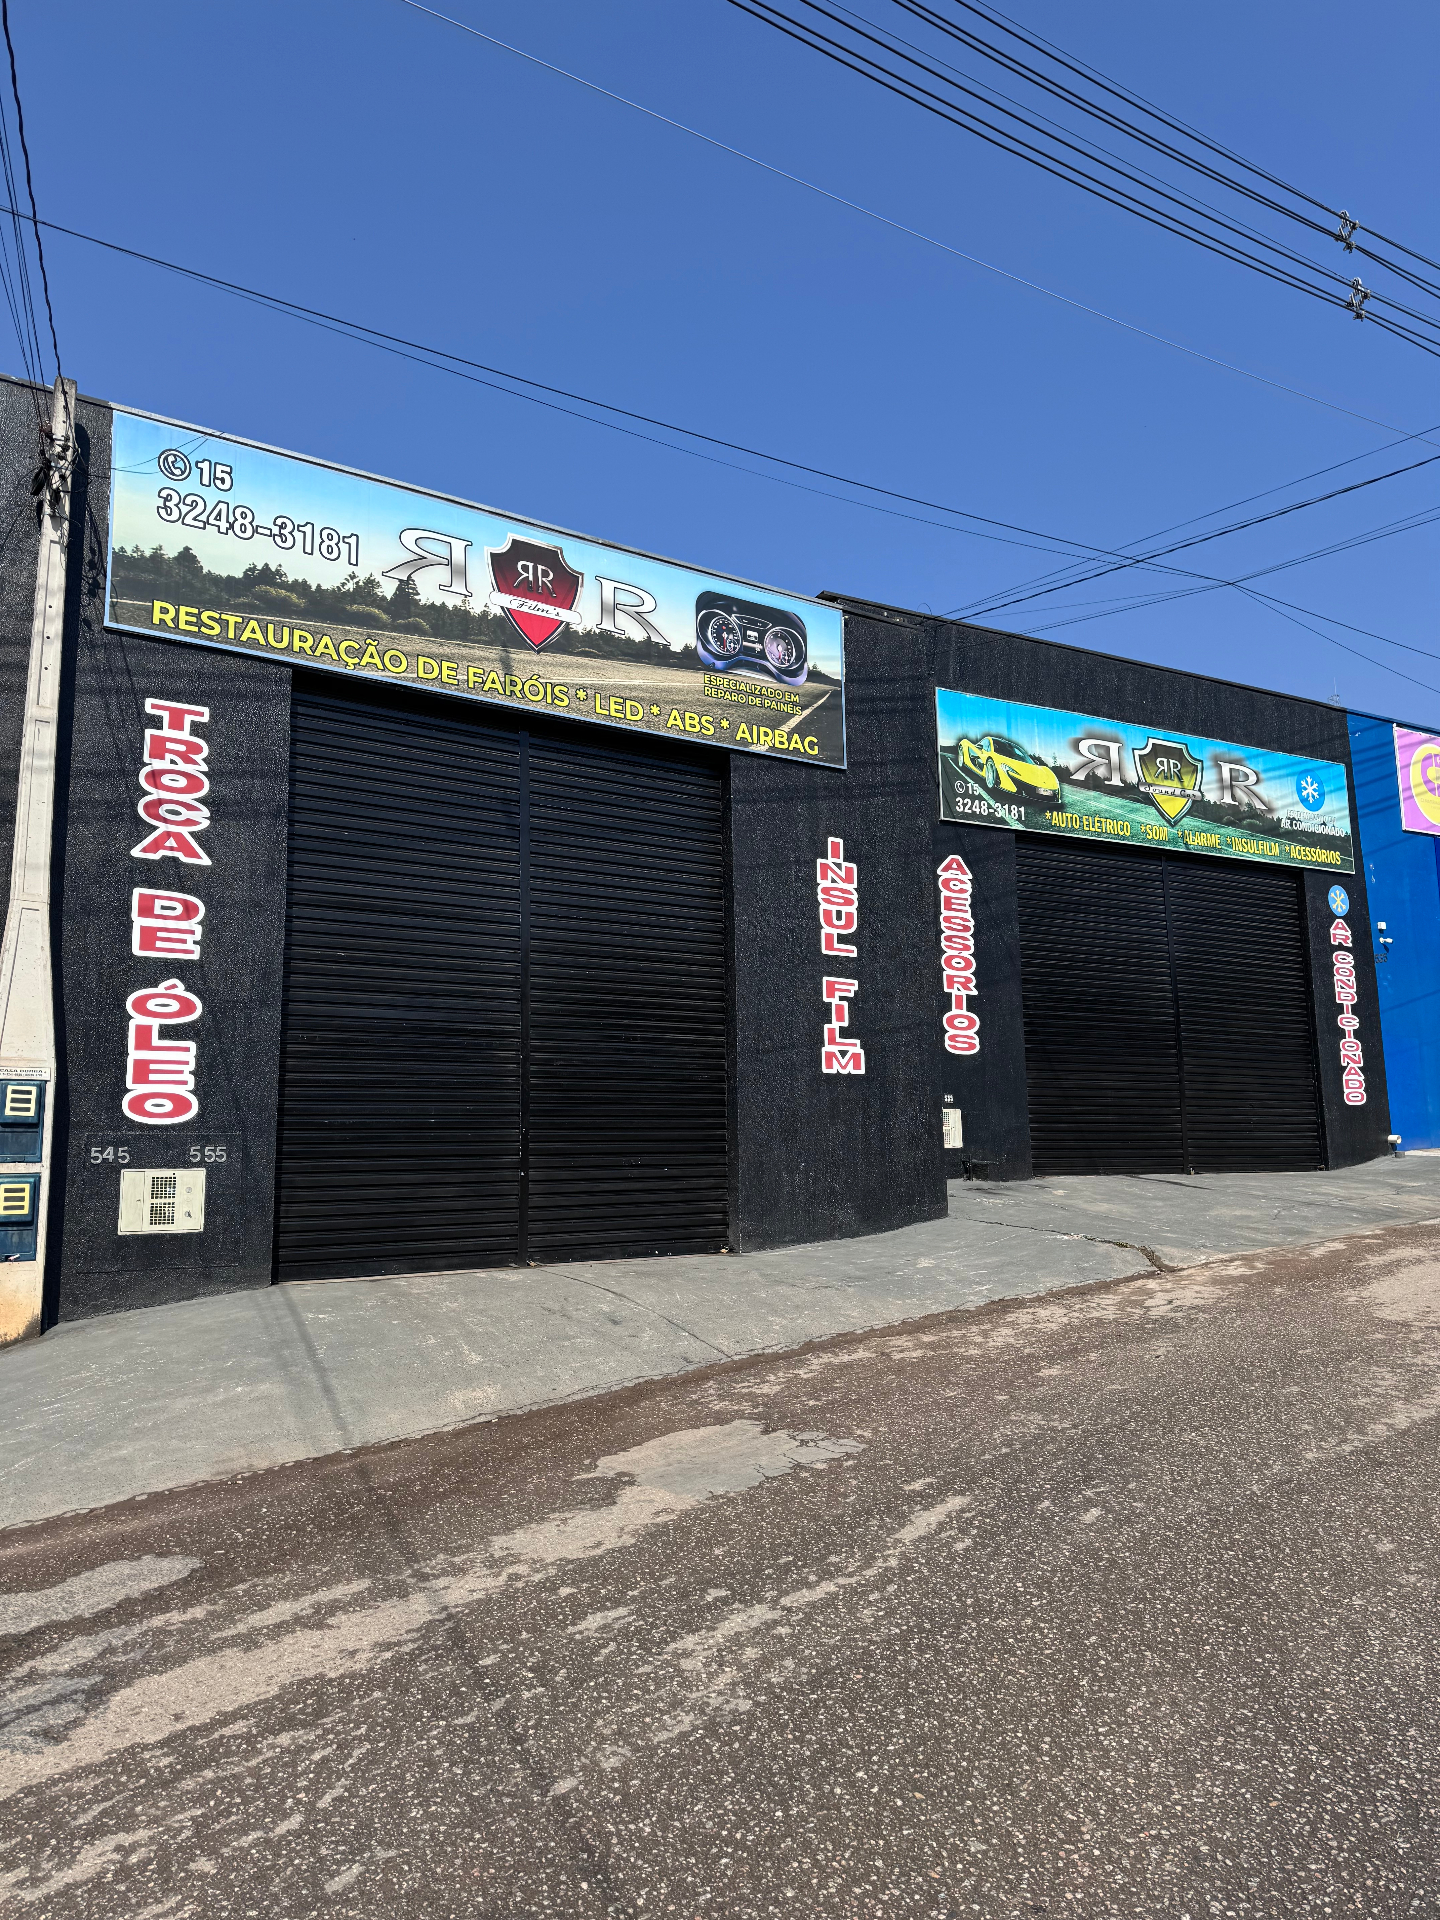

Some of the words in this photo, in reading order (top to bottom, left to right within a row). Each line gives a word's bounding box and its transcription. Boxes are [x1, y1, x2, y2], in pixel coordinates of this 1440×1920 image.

[196, 458, 233, 492] 15
[156, 487, 359, 567] 3248-3181
[595, 575, 671, 647] R
[151, 599, 409, 673] RESTAURAÇÃO
[416, 654, 459, 686] DE
[467, 665, 570, 707] FARÓIS
[595, 692, 644, 722] LED
[666, 708, 715, 737] ABS
[735, 722, 820, 756] AIRBAG
[704, 674, 783, 699] ESPECIALIZADO
[784, 692, 800, 703] EM
[704, 686, 746, 704] REPARO
[748, 695, 762, 707] DE
[764, 699, 802, 716] PAINÉIS
[130, 697, 212, 866] TROCA
[967, 783, 979, 796] 15
[1218, 761, 1269, 810] R
[955, 797, 1025, 821] 3248-3181
[1083, 815, 1131, 837] ELÉTRICO
[1281, 818, 1291, 829] AR
[1293, 820, 1345, 838] CONDICIONADO
[817, 837, 858, 957] INSUL
[131, 887, 206, 960] DE
[1330, 919, 1352, 947] AR
[822, 976, 865, 1075] FILM
[1333, 951, 1366, 1105] CONDICIONADO
[121, 978, 203, 1125] ÓLEO
[90, 1146, 130, 1165] 545
